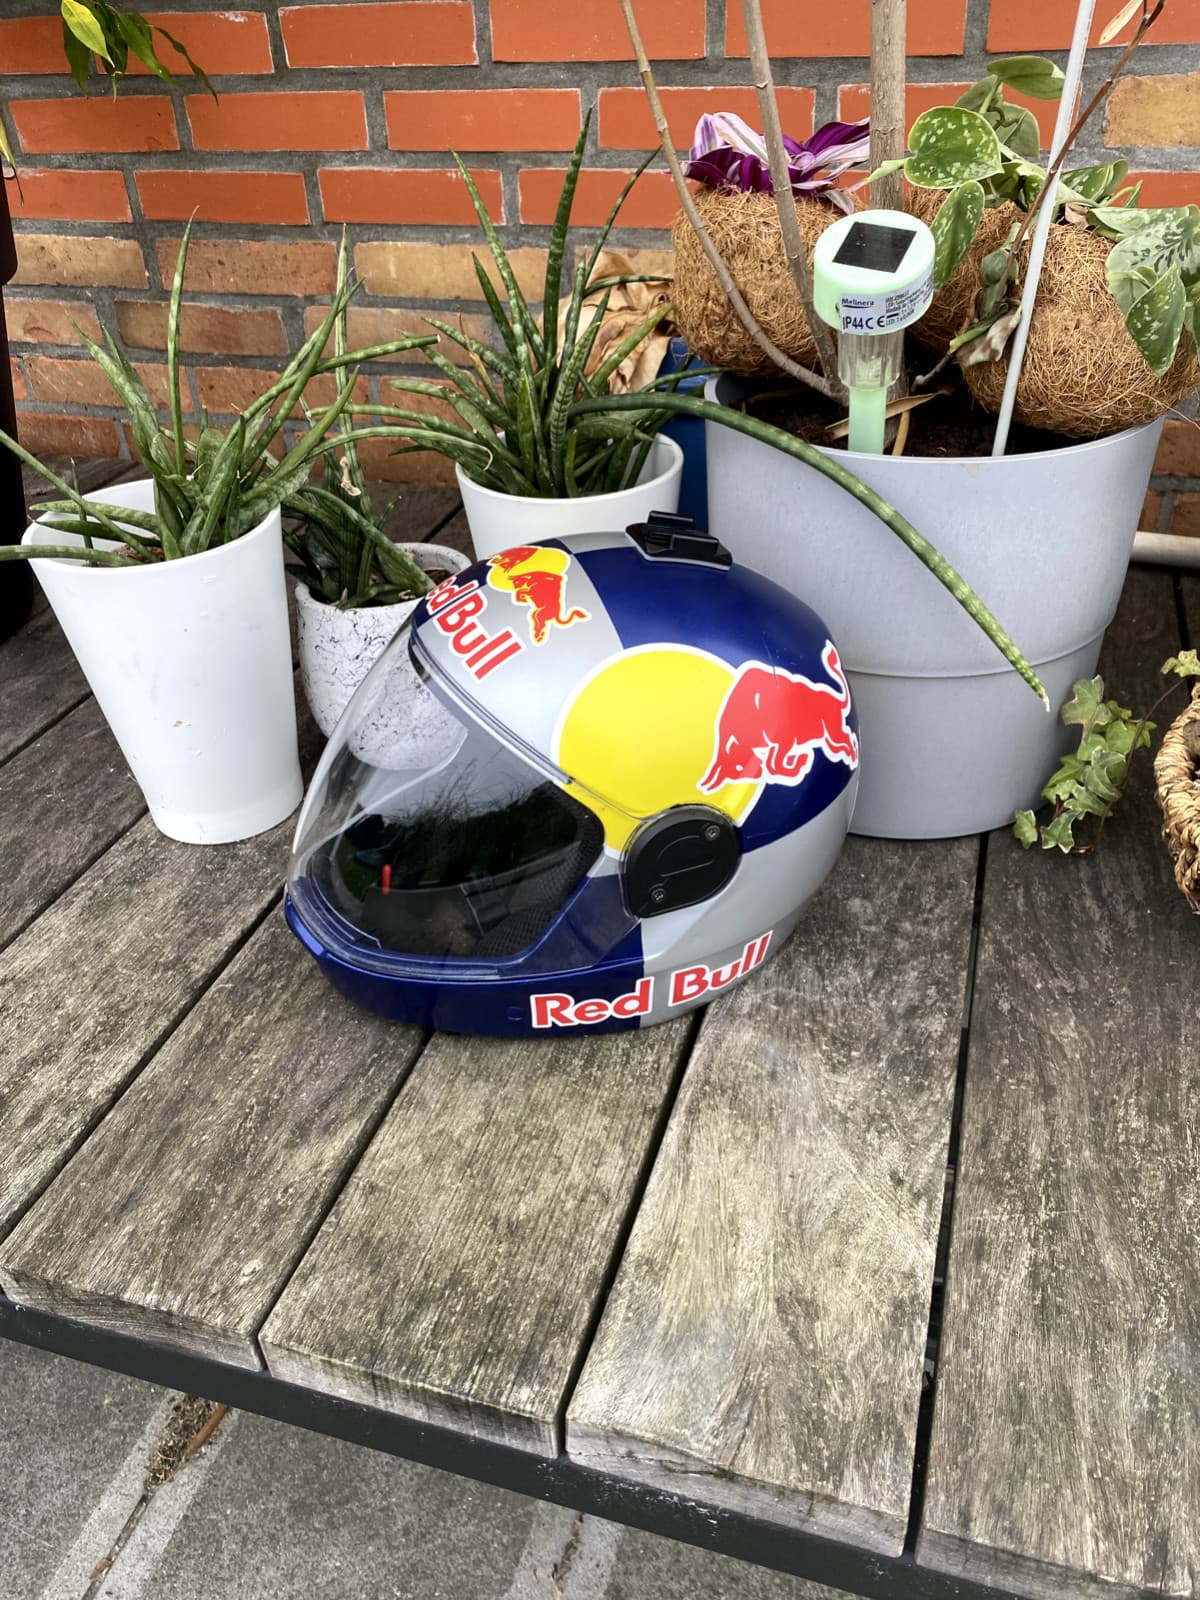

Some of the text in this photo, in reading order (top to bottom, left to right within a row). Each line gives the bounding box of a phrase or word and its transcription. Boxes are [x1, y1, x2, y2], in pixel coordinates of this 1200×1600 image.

[842, 315, 864, 330] IP44
[436, 592, 523, 681] Bull
[533, 932, 771, 1027] Red Bull
